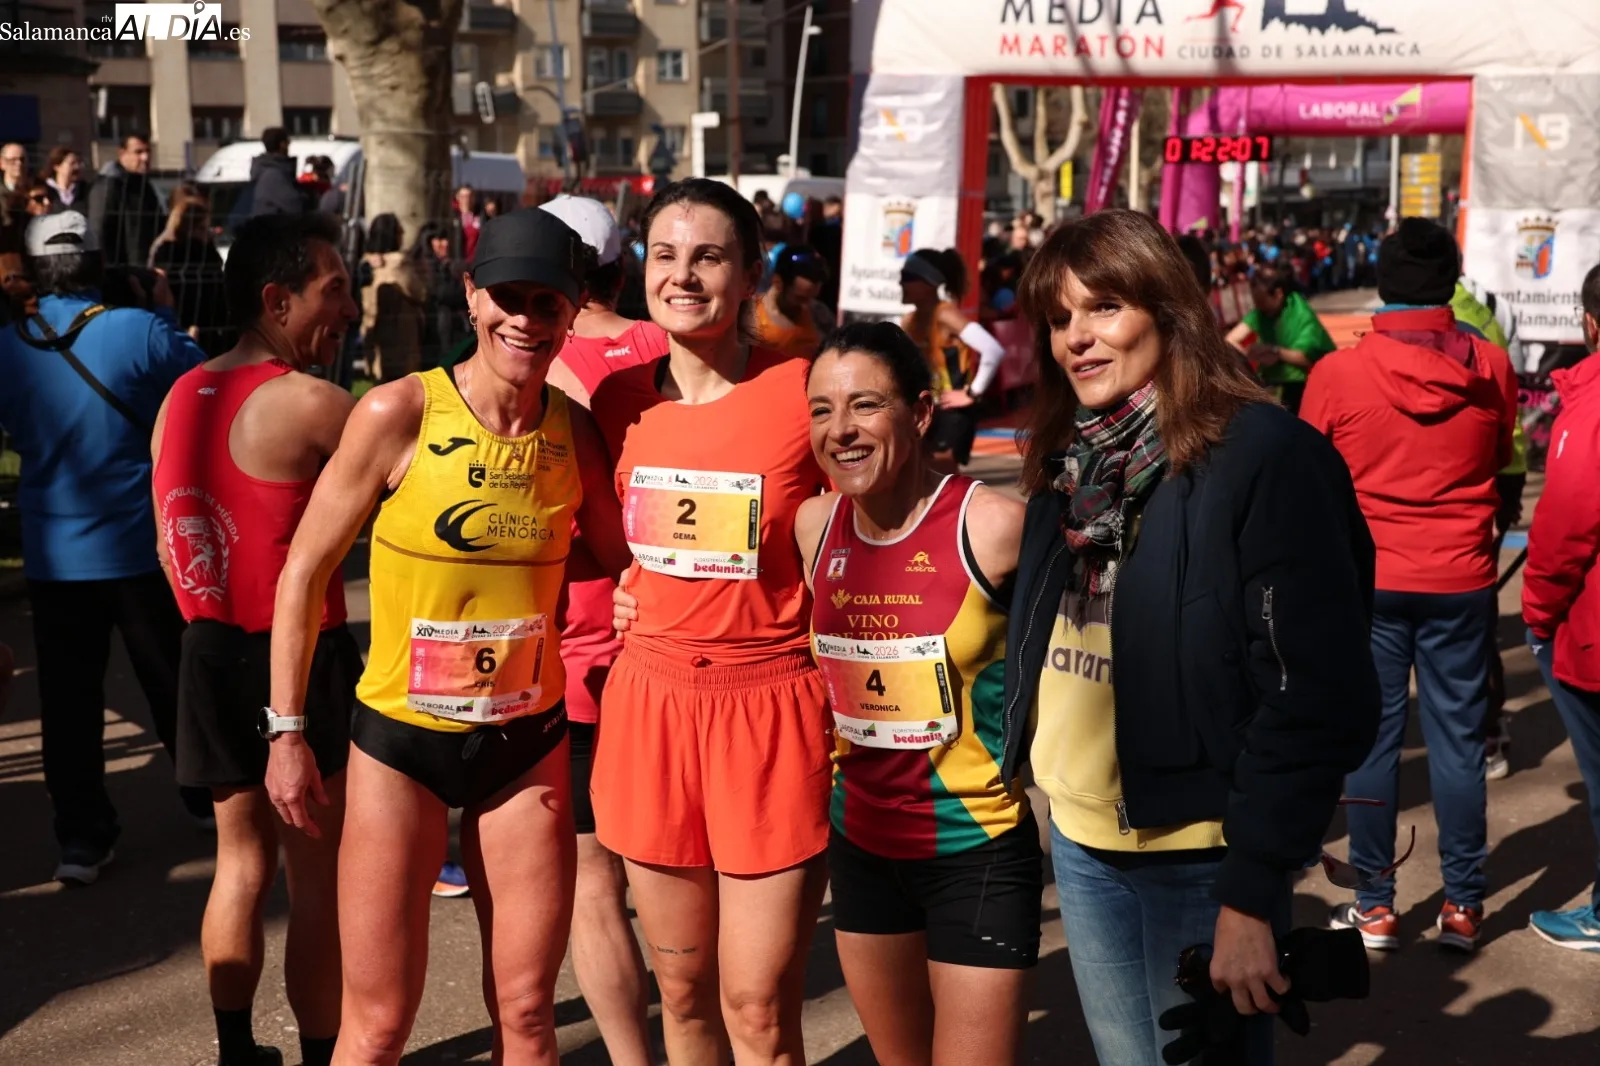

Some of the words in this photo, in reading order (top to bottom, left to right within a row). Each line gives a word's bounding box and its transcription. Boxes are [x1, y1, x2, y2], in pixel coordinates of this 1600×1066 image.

[1001, 0, 1163, 25] MEDIA
[1000, 28, 1164, 59] MARATÓN
[1177, 44, 1251, 60] CIUDAD
[1261, 44, 1284, 59] DE
[1296, 42, 1422, 60] SALAMANCA
[1299, 101, 1380, 120] LABORAL
[489, 471, 504, 480] San
[694, 475, 718, 487] 2026
[489, 480, 499, 489] de
[500, 480, 509, 489] los
[488, 511, 538, 527] CLÍNICA
[676, 498, 697, 526] 2
[215, 503, 240, 544] MÉRIDA
[486, 525, 556, 541] MENORCA
[673, 532, 697, 541] GEMA
[853, 594, 881, 606] CAJA
[883, 594, 923, 605] RURAL
[846, 614, 899, 628] VINO
[416, 625, 435, 638] XIV
[434, 628, 459, 636] MEDIA
[873, 645, 899, 656] 2026
[475, 647, 497, 674] 6
[865, 669, 886, 697] 4
[415, 700, 455, 711] LABORAL
[860, 703, 901, 712] VERONICA
